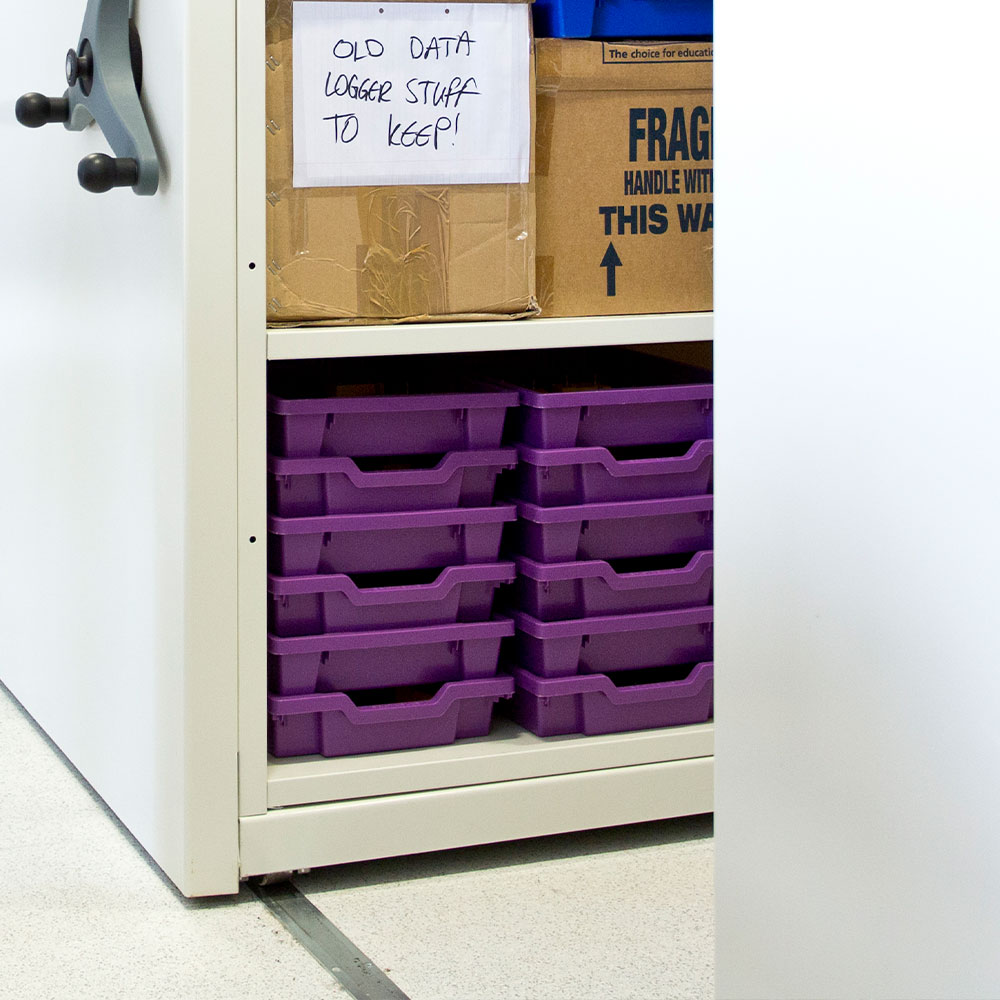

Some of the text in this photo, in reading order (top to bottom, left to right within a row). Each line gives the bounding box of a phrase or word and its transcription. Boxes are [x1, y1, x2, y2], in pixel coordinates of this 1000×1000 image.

[333, 30, 476, 62] OLD DATA
[609, 49, 628, 59] The
[630, 48, 660, 59] choice
[662, 48, 675, 58] for
[325, 72, 482, 108] LOGGER STUFF
[323, 112, 461, 150] TO KEEP!
[624, 169, 680, 195] HANDLE
[599, 203, 669, 235] THIS
